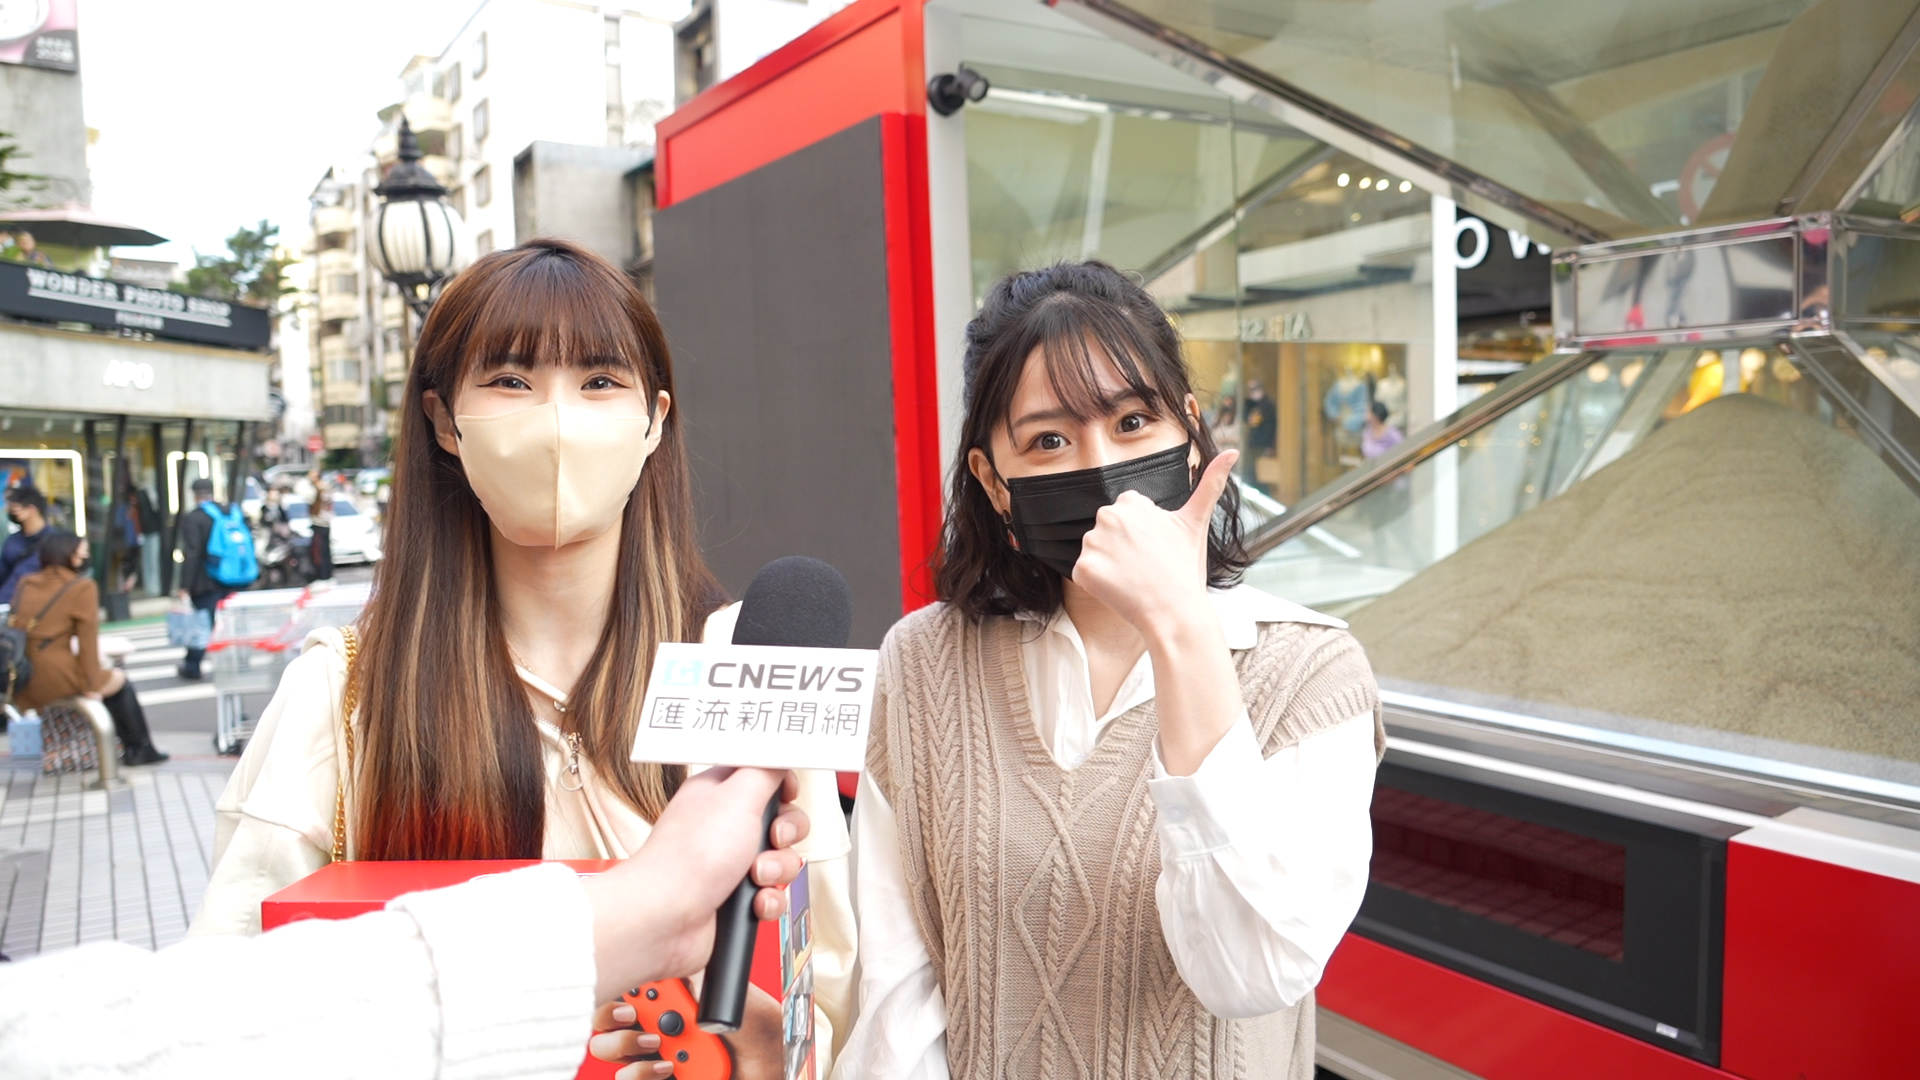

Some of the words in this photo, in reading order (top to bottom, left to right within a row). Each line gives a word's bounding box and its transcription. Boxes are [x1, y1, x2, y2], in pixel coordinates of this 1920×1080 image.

[26, 267, 119, 301] WONDER
[123, 286, 186, 312] PHOTO
[707, 662, 865, 693] CNEWS
[648, 696, 861, 736] 匯流新聞網
